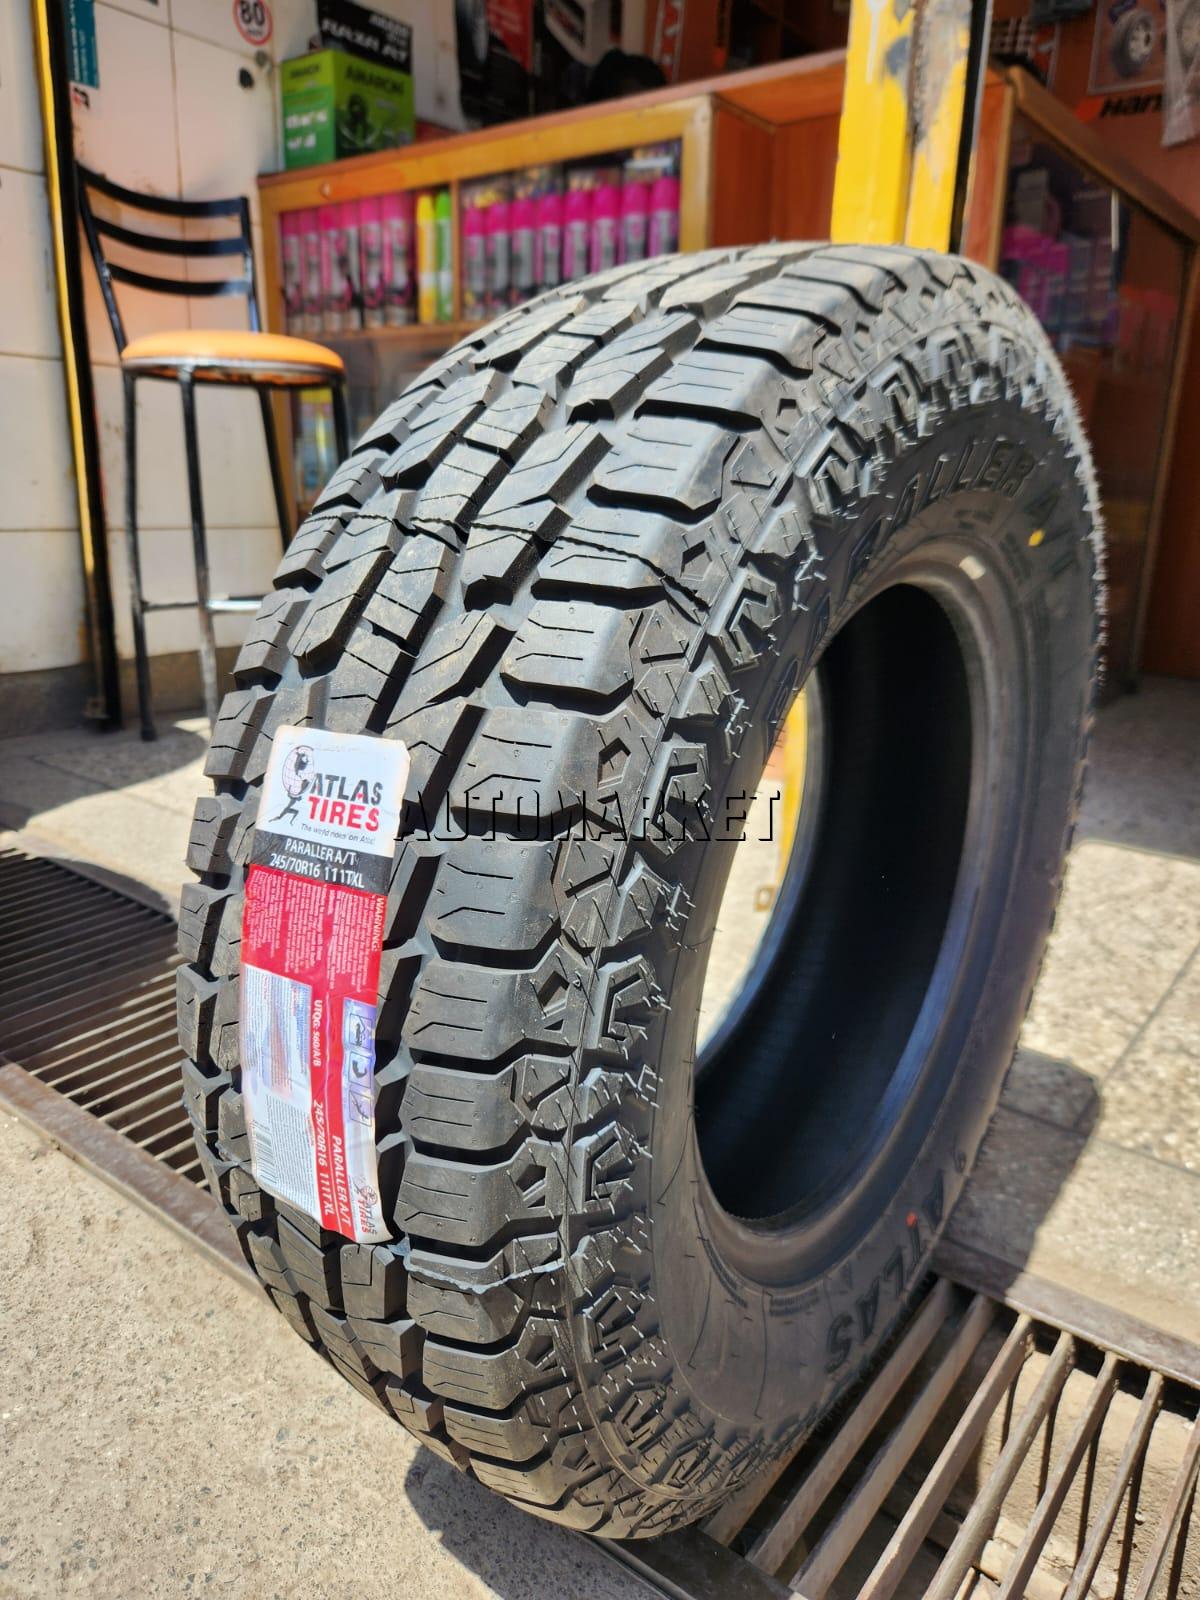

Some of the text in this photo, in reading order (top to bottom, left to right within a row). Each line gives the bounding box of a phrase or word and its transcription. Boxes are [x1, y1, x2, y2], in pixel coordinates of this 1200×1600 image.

[240, 0, 265, 26] 80
[310, 772, 383, 806] ATLAS
[307, 796, 380, 832] TIRES
[270, 852, 322, 878] 245/70R16
[284, 838, 357, 866] PARALLER A/T
[371, 897, 385, 952] WARNING:
[312, 1000, 323, 1067] UTQG: 560/A/B
[313, 1099, 327, 1167] 245/70R16
[332, 1135, 351, 1227] PARALLER A/T
[358, 1197, 369, 1234] TIRES
